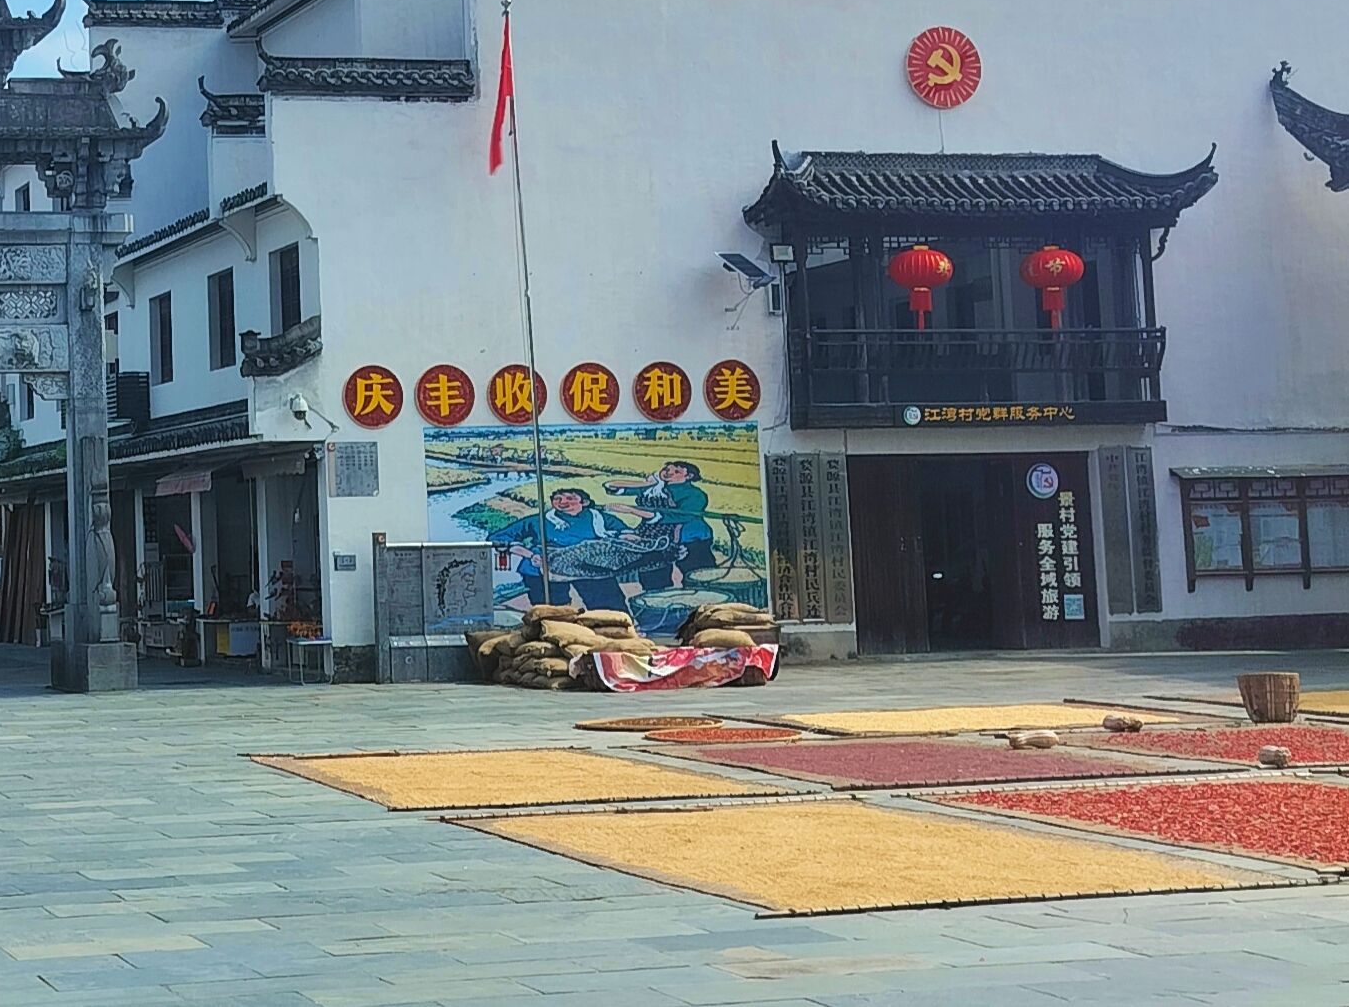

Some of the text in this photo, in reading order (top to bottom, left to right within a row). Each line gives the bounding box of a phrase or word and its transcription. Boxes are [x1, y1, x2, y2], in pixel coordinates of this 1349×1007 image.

[352, 366, 755, 419] 庆丰收促和美
[800, 458, 822, 620] 婺源县江湾镇江湾村民兵连
[826, 458, 847, 617] 婺源县江湾镇江湾村民委员会
[1037, 523, 1060, 621] 服务全域旅游
